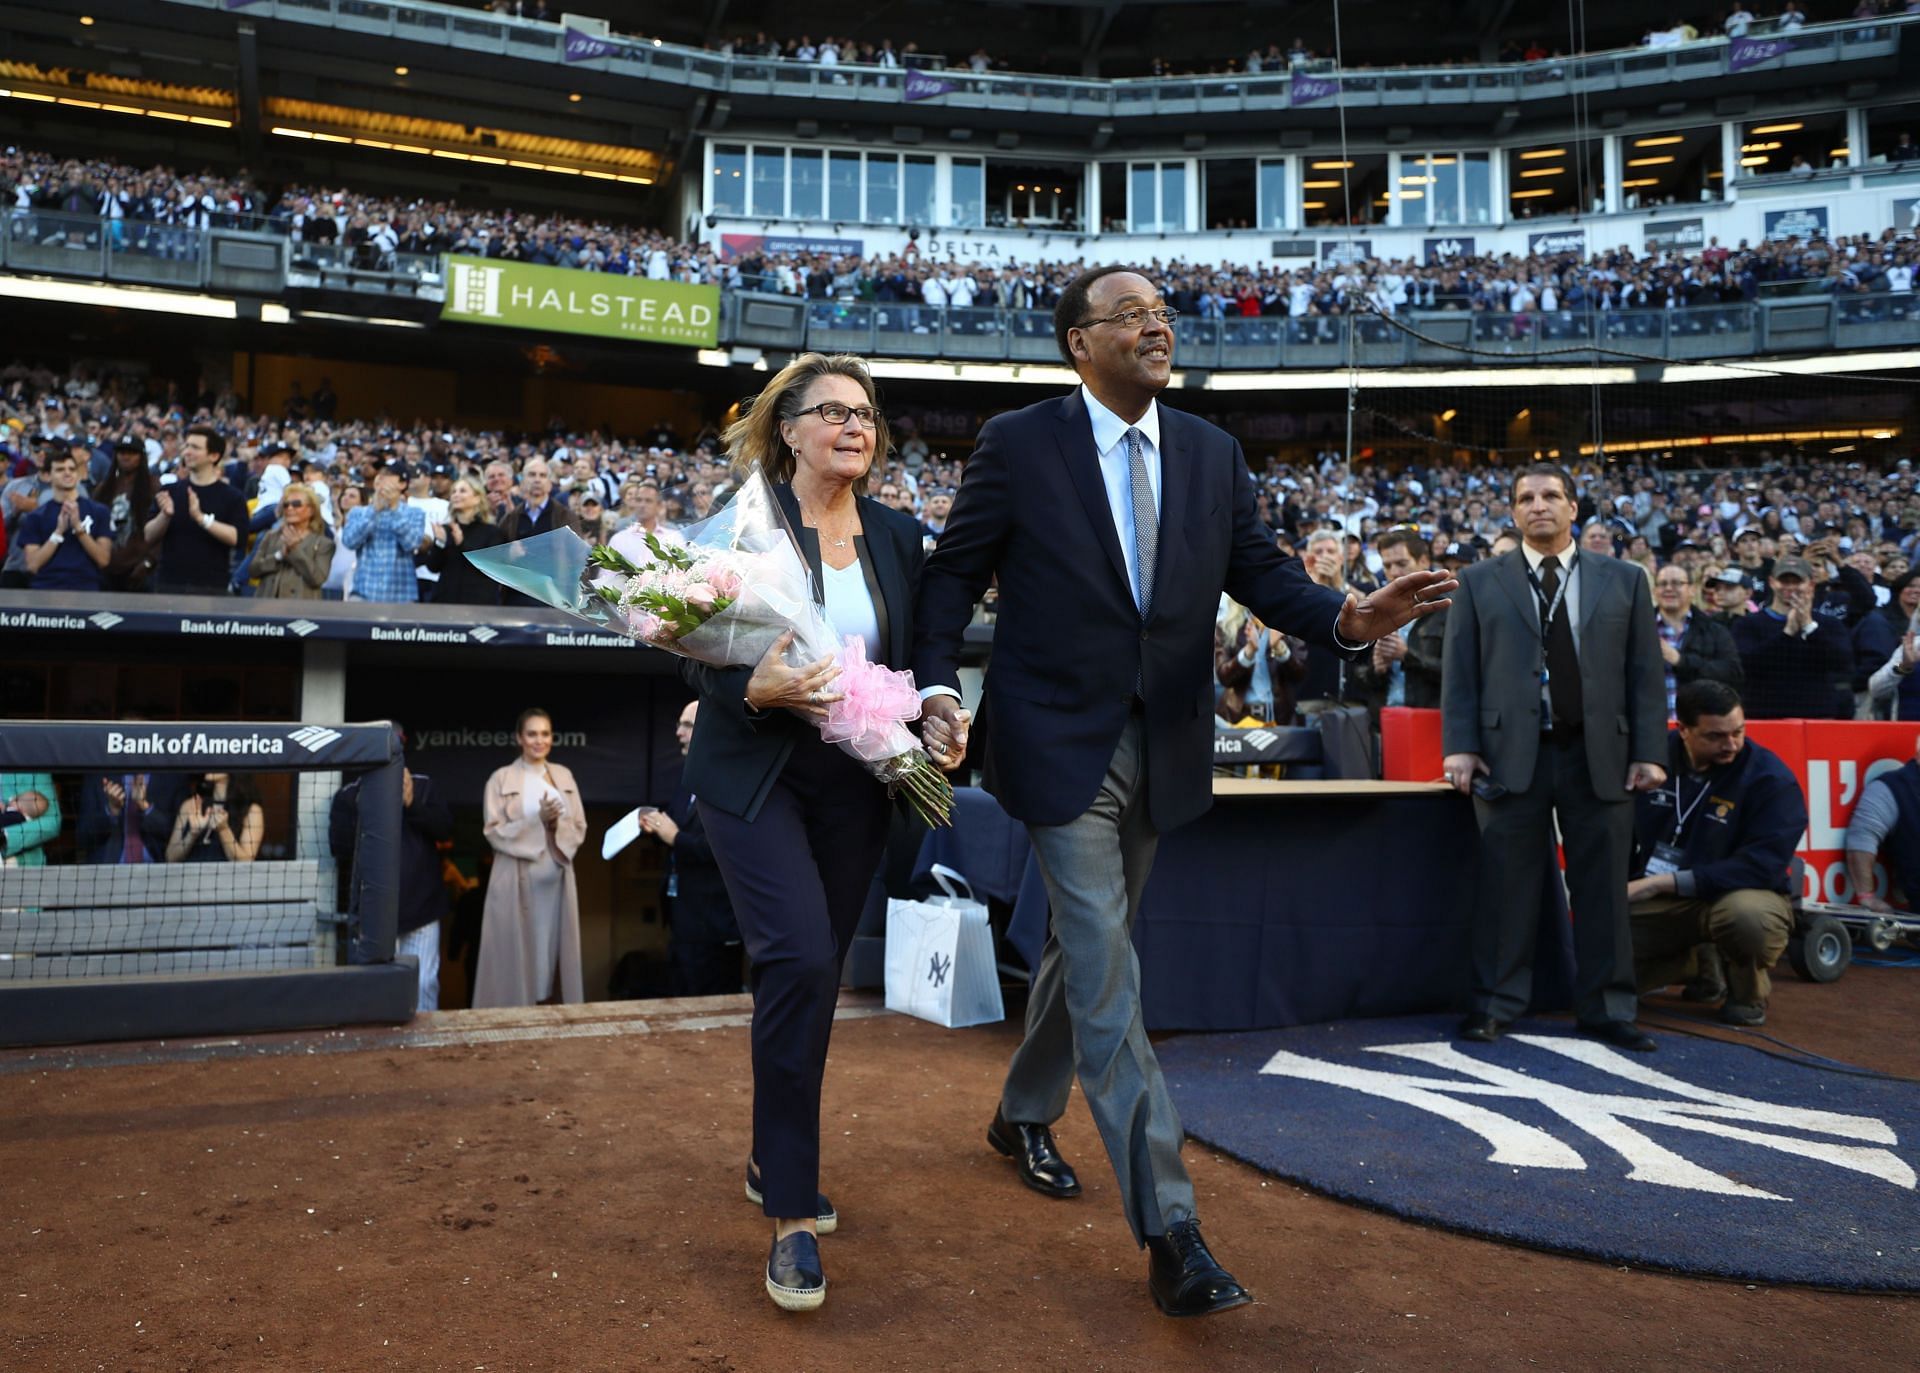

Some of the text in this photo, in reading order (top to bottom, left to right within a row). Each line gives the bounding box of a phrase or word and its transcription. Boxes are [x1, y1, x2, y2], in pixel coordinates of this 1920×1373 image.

[928, 240, 999, 256] DELTA
[511, 284, 712, 328] HALSTEAD
[621, 322, 709, 340] REAL ESTATE
[10, 612, 27, 627] of
[27, 613, 86, 629] America
[180, 619, 285, 636] Bank of America
[371, 627, 467, 643] Bank of America
[546, 633, 635, 648] Bank of America
[107, 732, 283, 754] Bank of America
[1258, 1032, 1918, 1202] NY
